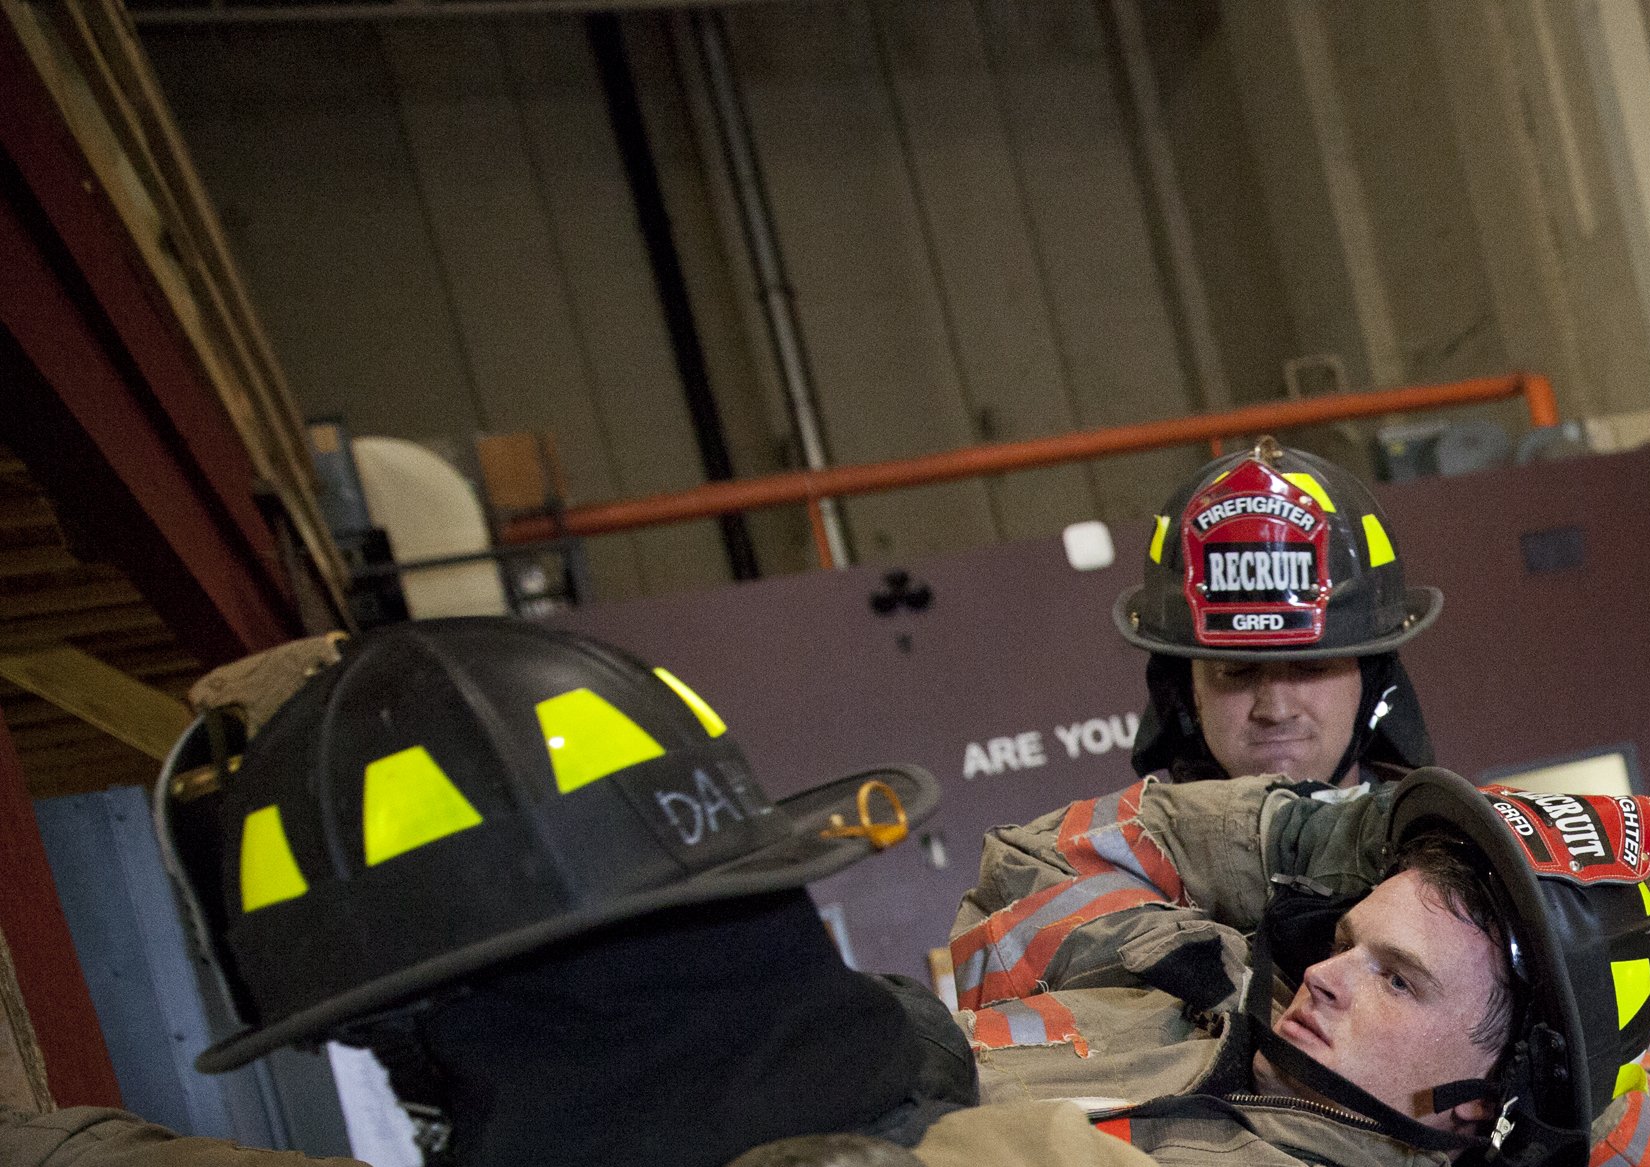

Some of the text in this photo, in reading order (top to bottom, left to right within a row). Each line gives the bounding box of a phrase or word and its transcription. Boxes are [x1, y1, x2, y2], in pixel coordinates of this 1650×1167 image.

[1196, 497, 1315, 531] FIREFIGHTER
[1208, 551, 1312, 591] RECRUIT
[1232, 614, 1284, 630] GRFD
[963, 712, 1140, 780] ARE YOU
[1493, 802, 1534, 836] GRFD
